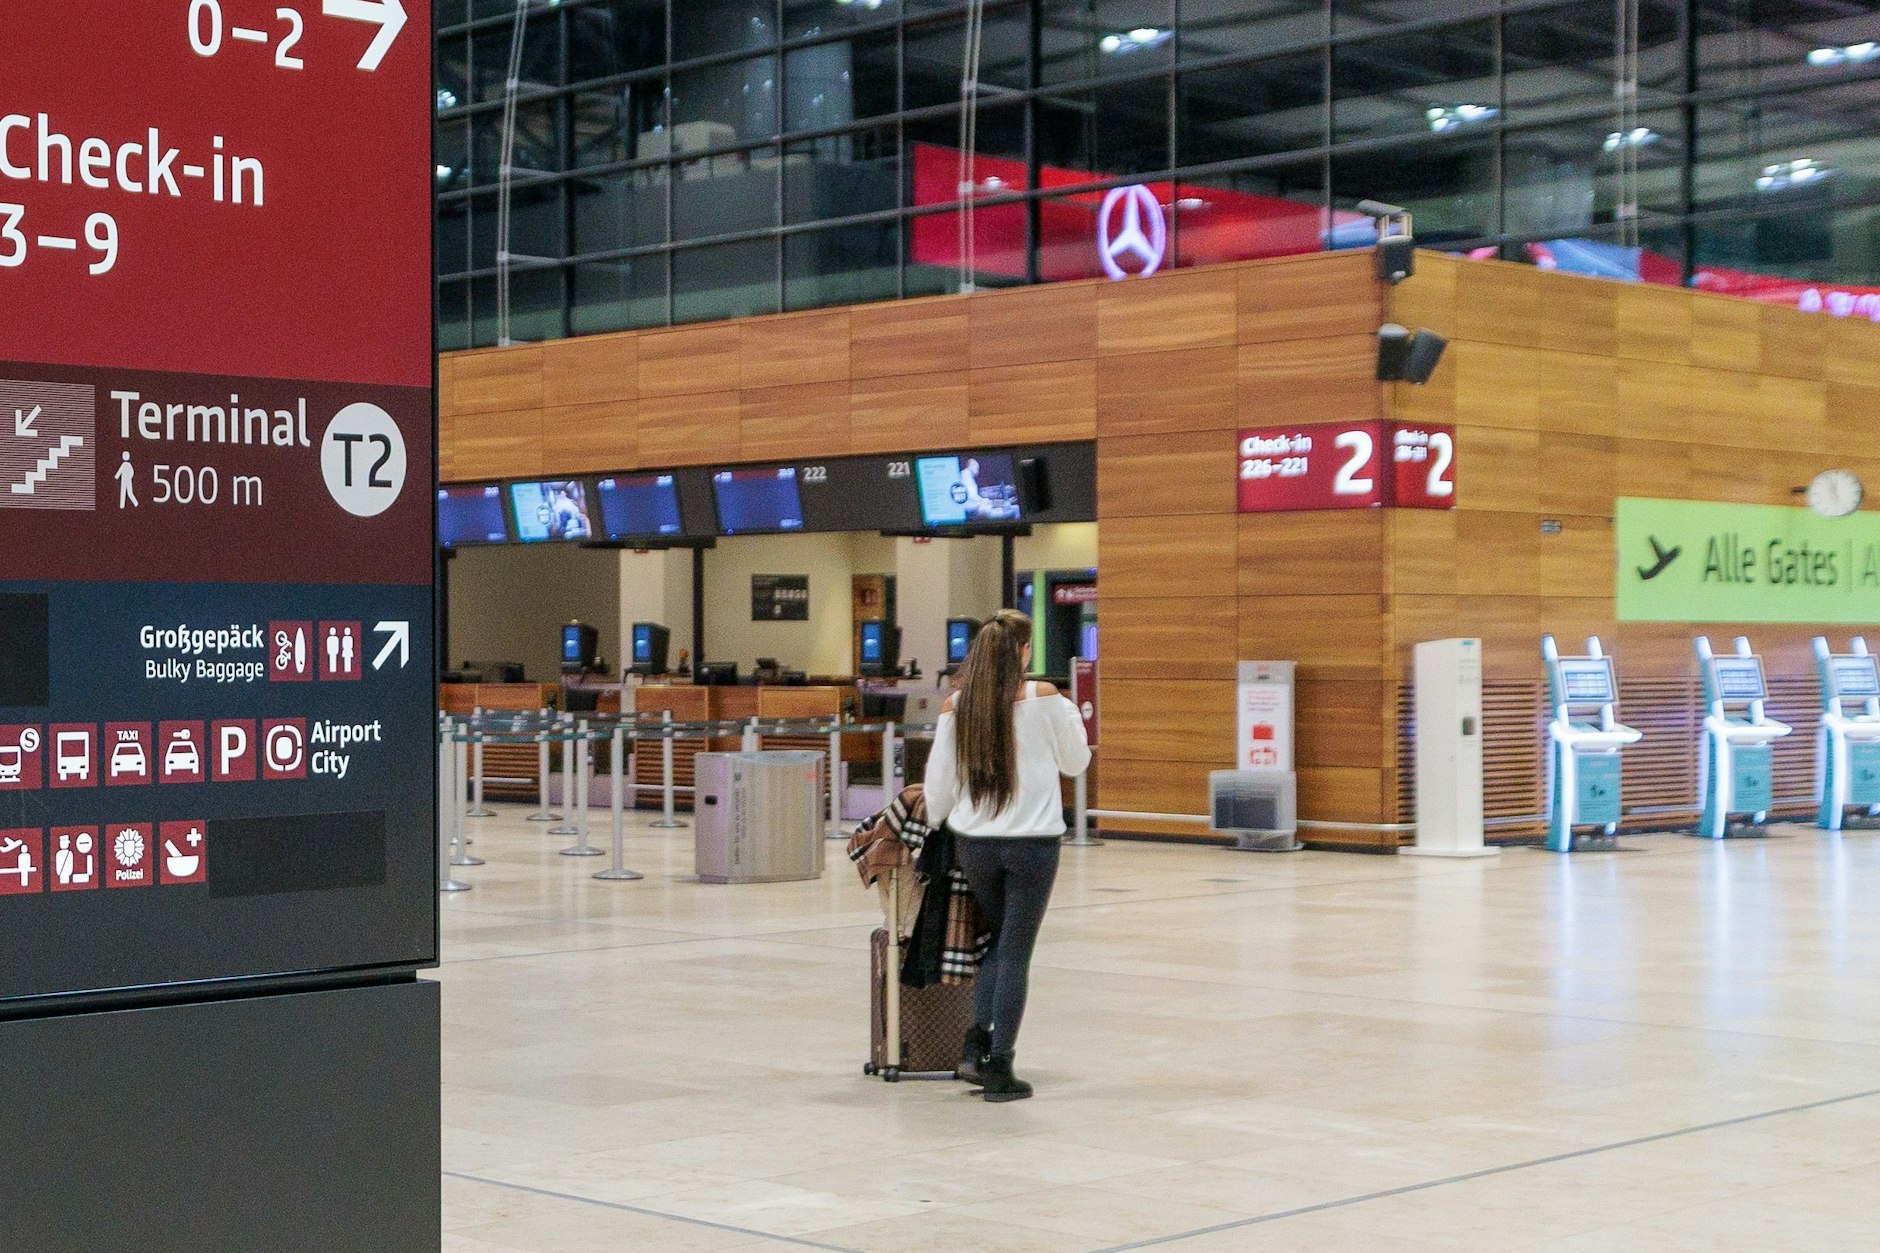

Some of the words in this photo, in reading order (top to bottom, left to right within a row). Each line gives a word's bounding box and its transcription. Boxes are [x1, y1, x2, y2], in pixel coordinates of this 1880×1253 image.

[188, 0, 303, 70] 0–2
[0, 113, 264, 207] Check-in
[0, 203, 119, 275] 3–9
[110, 390, 311, 447] Terminal
[333, 433, 393, 488] T2
[1240, 433, 1312, 457] Check-in
[1333, 430, 1373, 494] 2
[1426, 432, 1453, 495] 2
[153, 465, 218, 504] 500
[233, 475, 263, 505] m
[803, 466, 828, 481] 222
[887, 461, 910, 478] 221
[1703, 531, 1757, 583] Alle
[1766, 537, 1838, 585] Gates
[140, 624, 264, 654] Großgepäck
[146, 659, 191, 683] Bulky
[195, 660, 264, 683] Baggage
[117, 730, 138, 741] TAXI
[220, 726, 247, 775] P
[311, 719, 382, 744] Airport
[311, 751, 350, 779] City
[115, 868, 144, 881] Polizei
